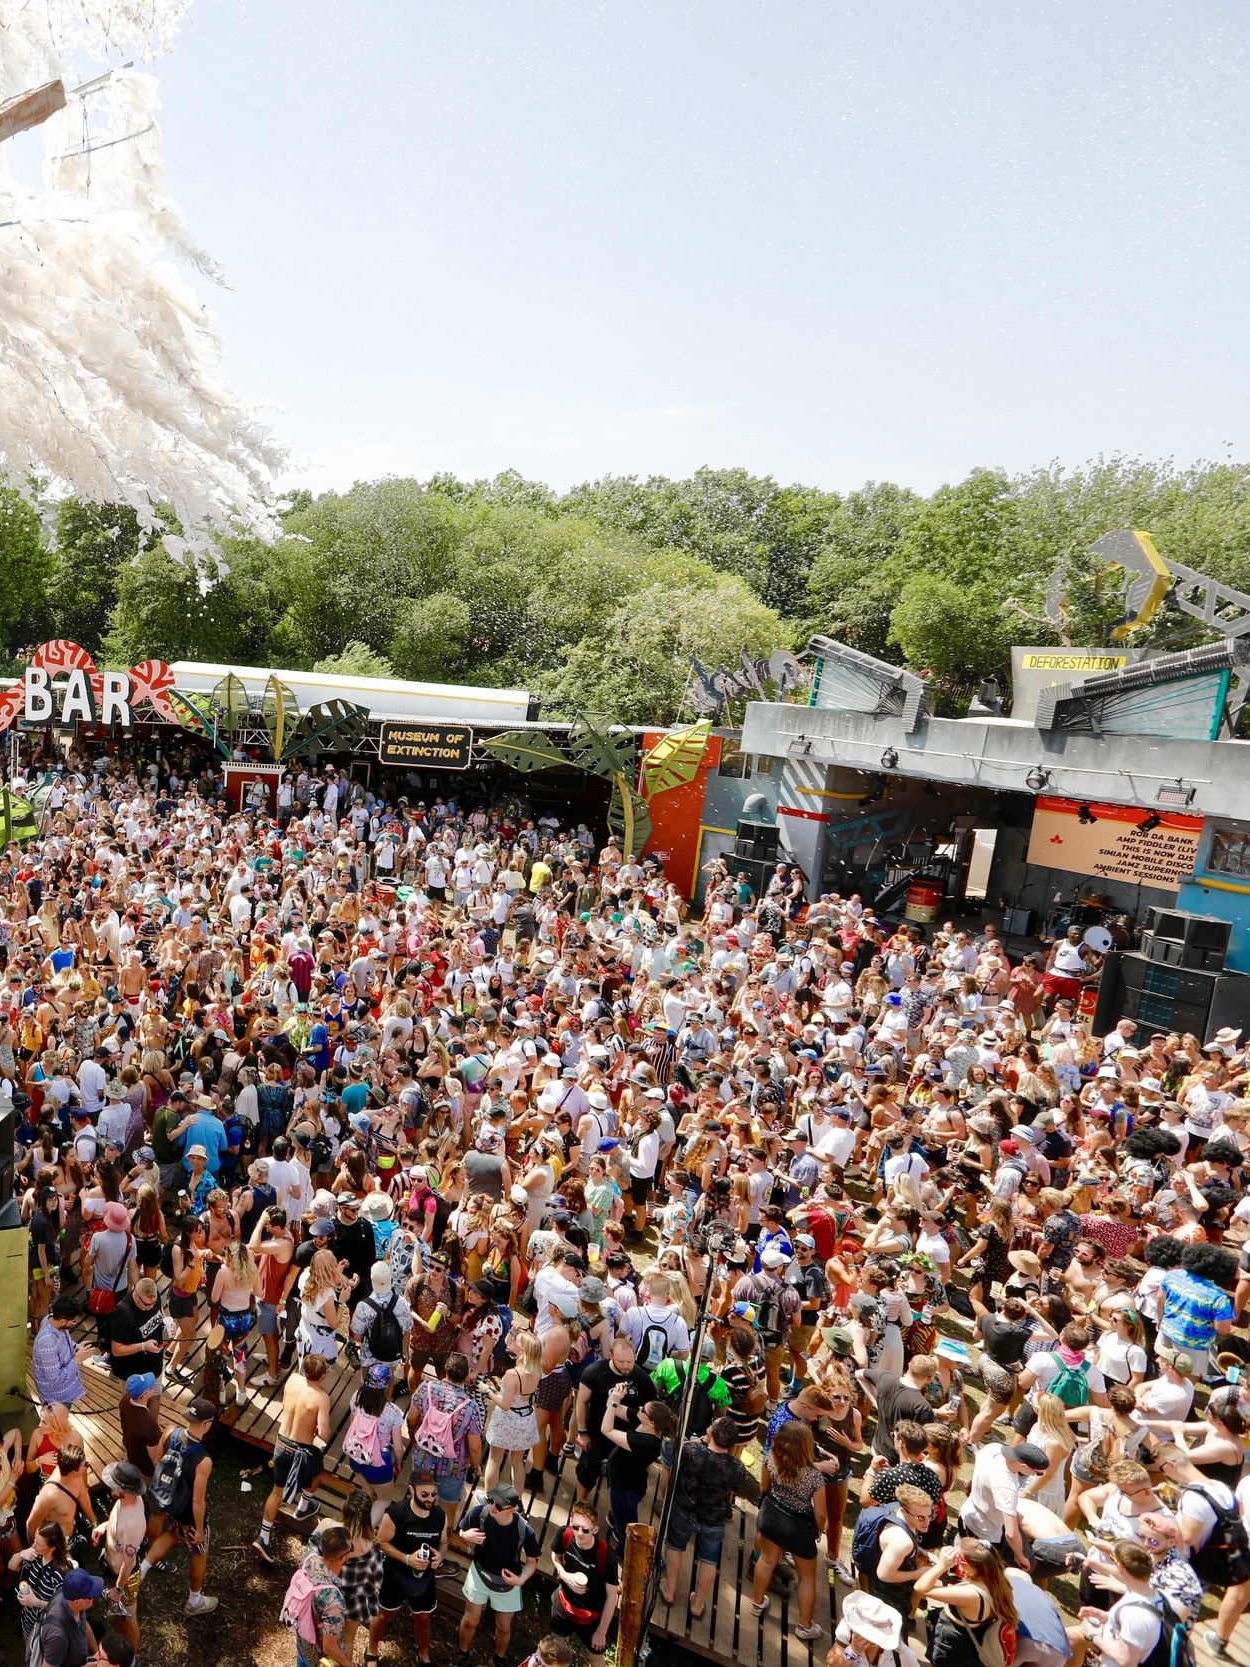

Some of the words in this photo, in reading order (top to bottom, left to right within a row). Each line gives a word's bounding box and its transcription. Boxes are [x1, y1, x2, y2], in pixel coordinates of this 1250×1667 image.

[1029, 655, 1120, 670] DEFORESTATION
[25, 667, 133, 731] BAR
[388, 730, 440, 743] MUSEUM
[446, 734, 465, 744] OF
[386, 744, 461, 759] EXTINCTION
[1116, 836, 1136, 844] AMP
[1138, 839, 1175, 851] FIDDLER
[1177, 845, 1198, 854] (LIV
[1130, 830, 1149, 838] ROB
[1151, 833, 1164, 841] DA
[1167, 836, 1194, 845] BANK
[1098, 848, 1129, 859] SIMIAN
[1130, 854, 1164, 865] MOBILE
[1166, 860, 1194, 870] DISCO
[1121, 845, 1140, 853] THIS
[1153, 849, 1175, 858] NOW
[1177, 854, 1194, 862] DJS
[1116, 860, 1140, 869] JAMZ
[1093, 863, 1131, 875] AMBIENT
[1133, 870, 1175, 882] SESSIONS
[160, 1473, 173, 1485] CAT
